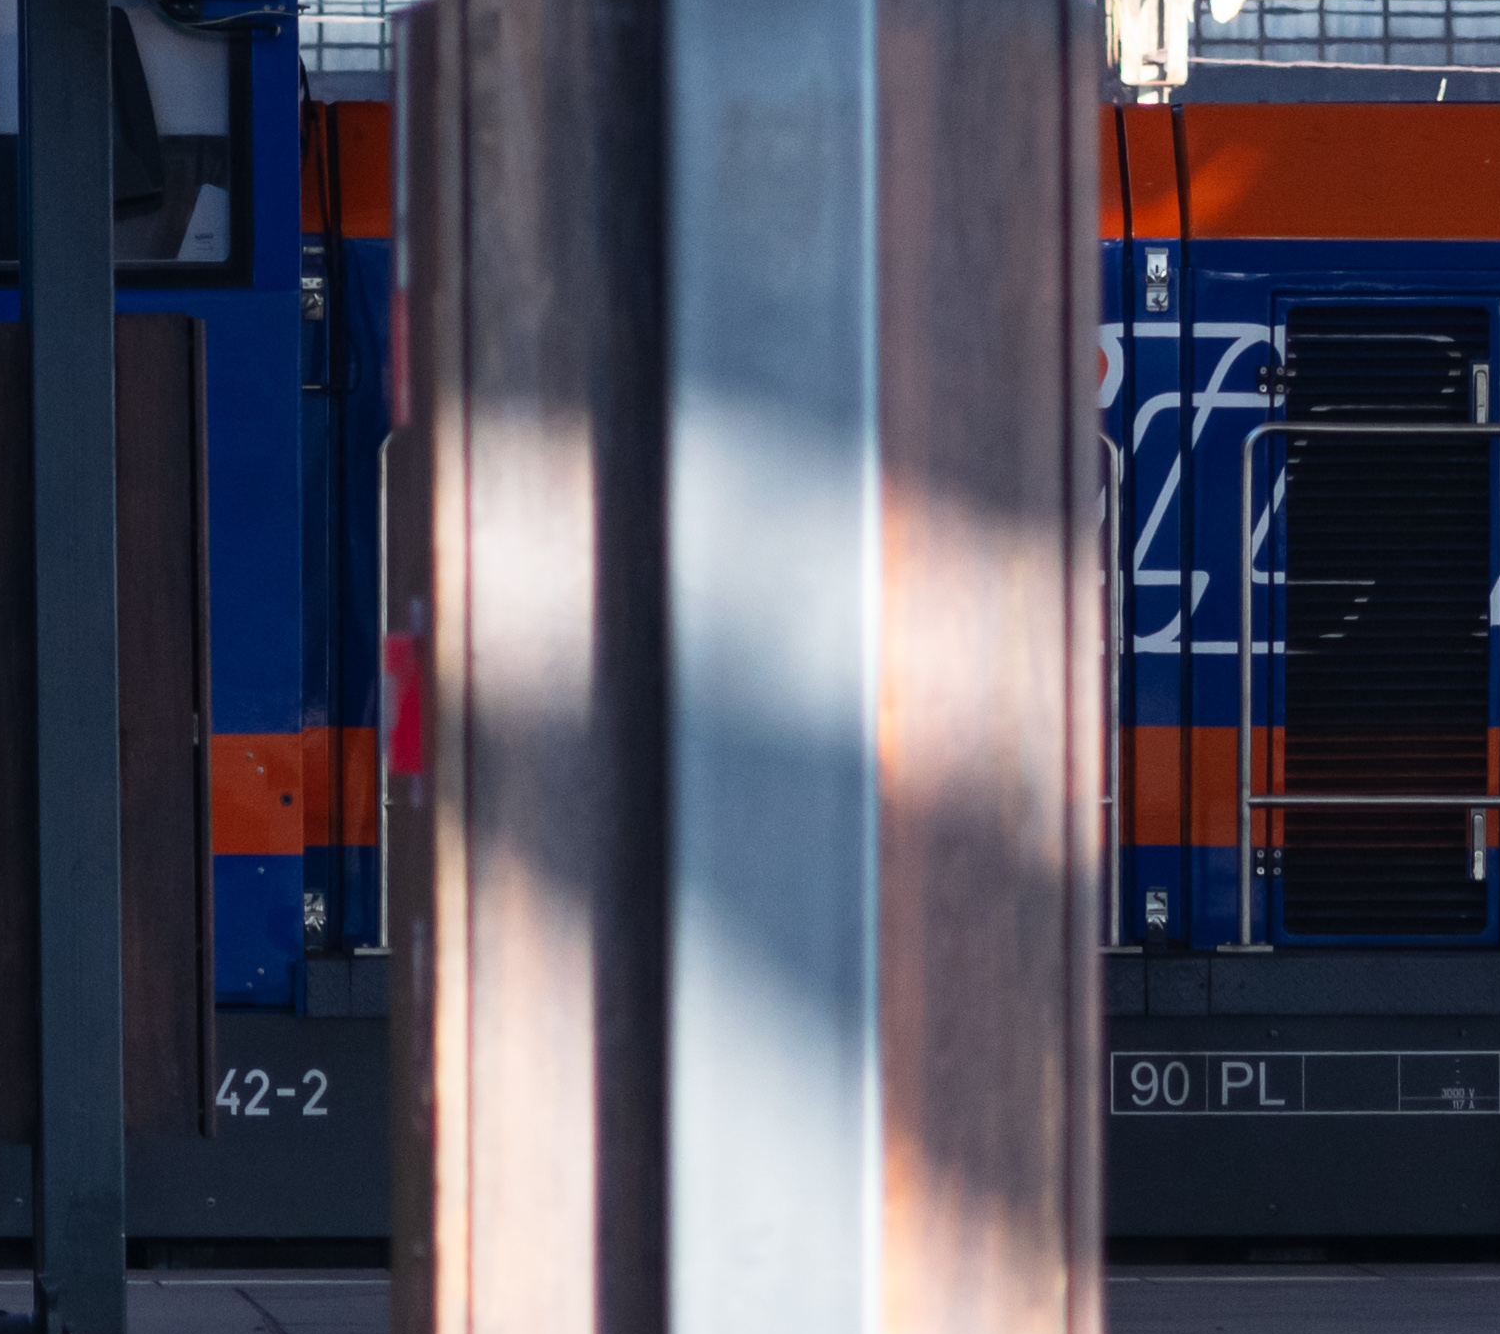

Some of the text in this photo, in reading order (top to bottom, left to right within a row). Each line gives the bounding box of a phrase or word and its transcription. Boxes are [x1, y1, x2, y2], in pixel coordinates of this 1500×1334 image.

[216, 1068, 329, 1116] 42-2
[1130, 1061, 1286, 1105] 90 PL
